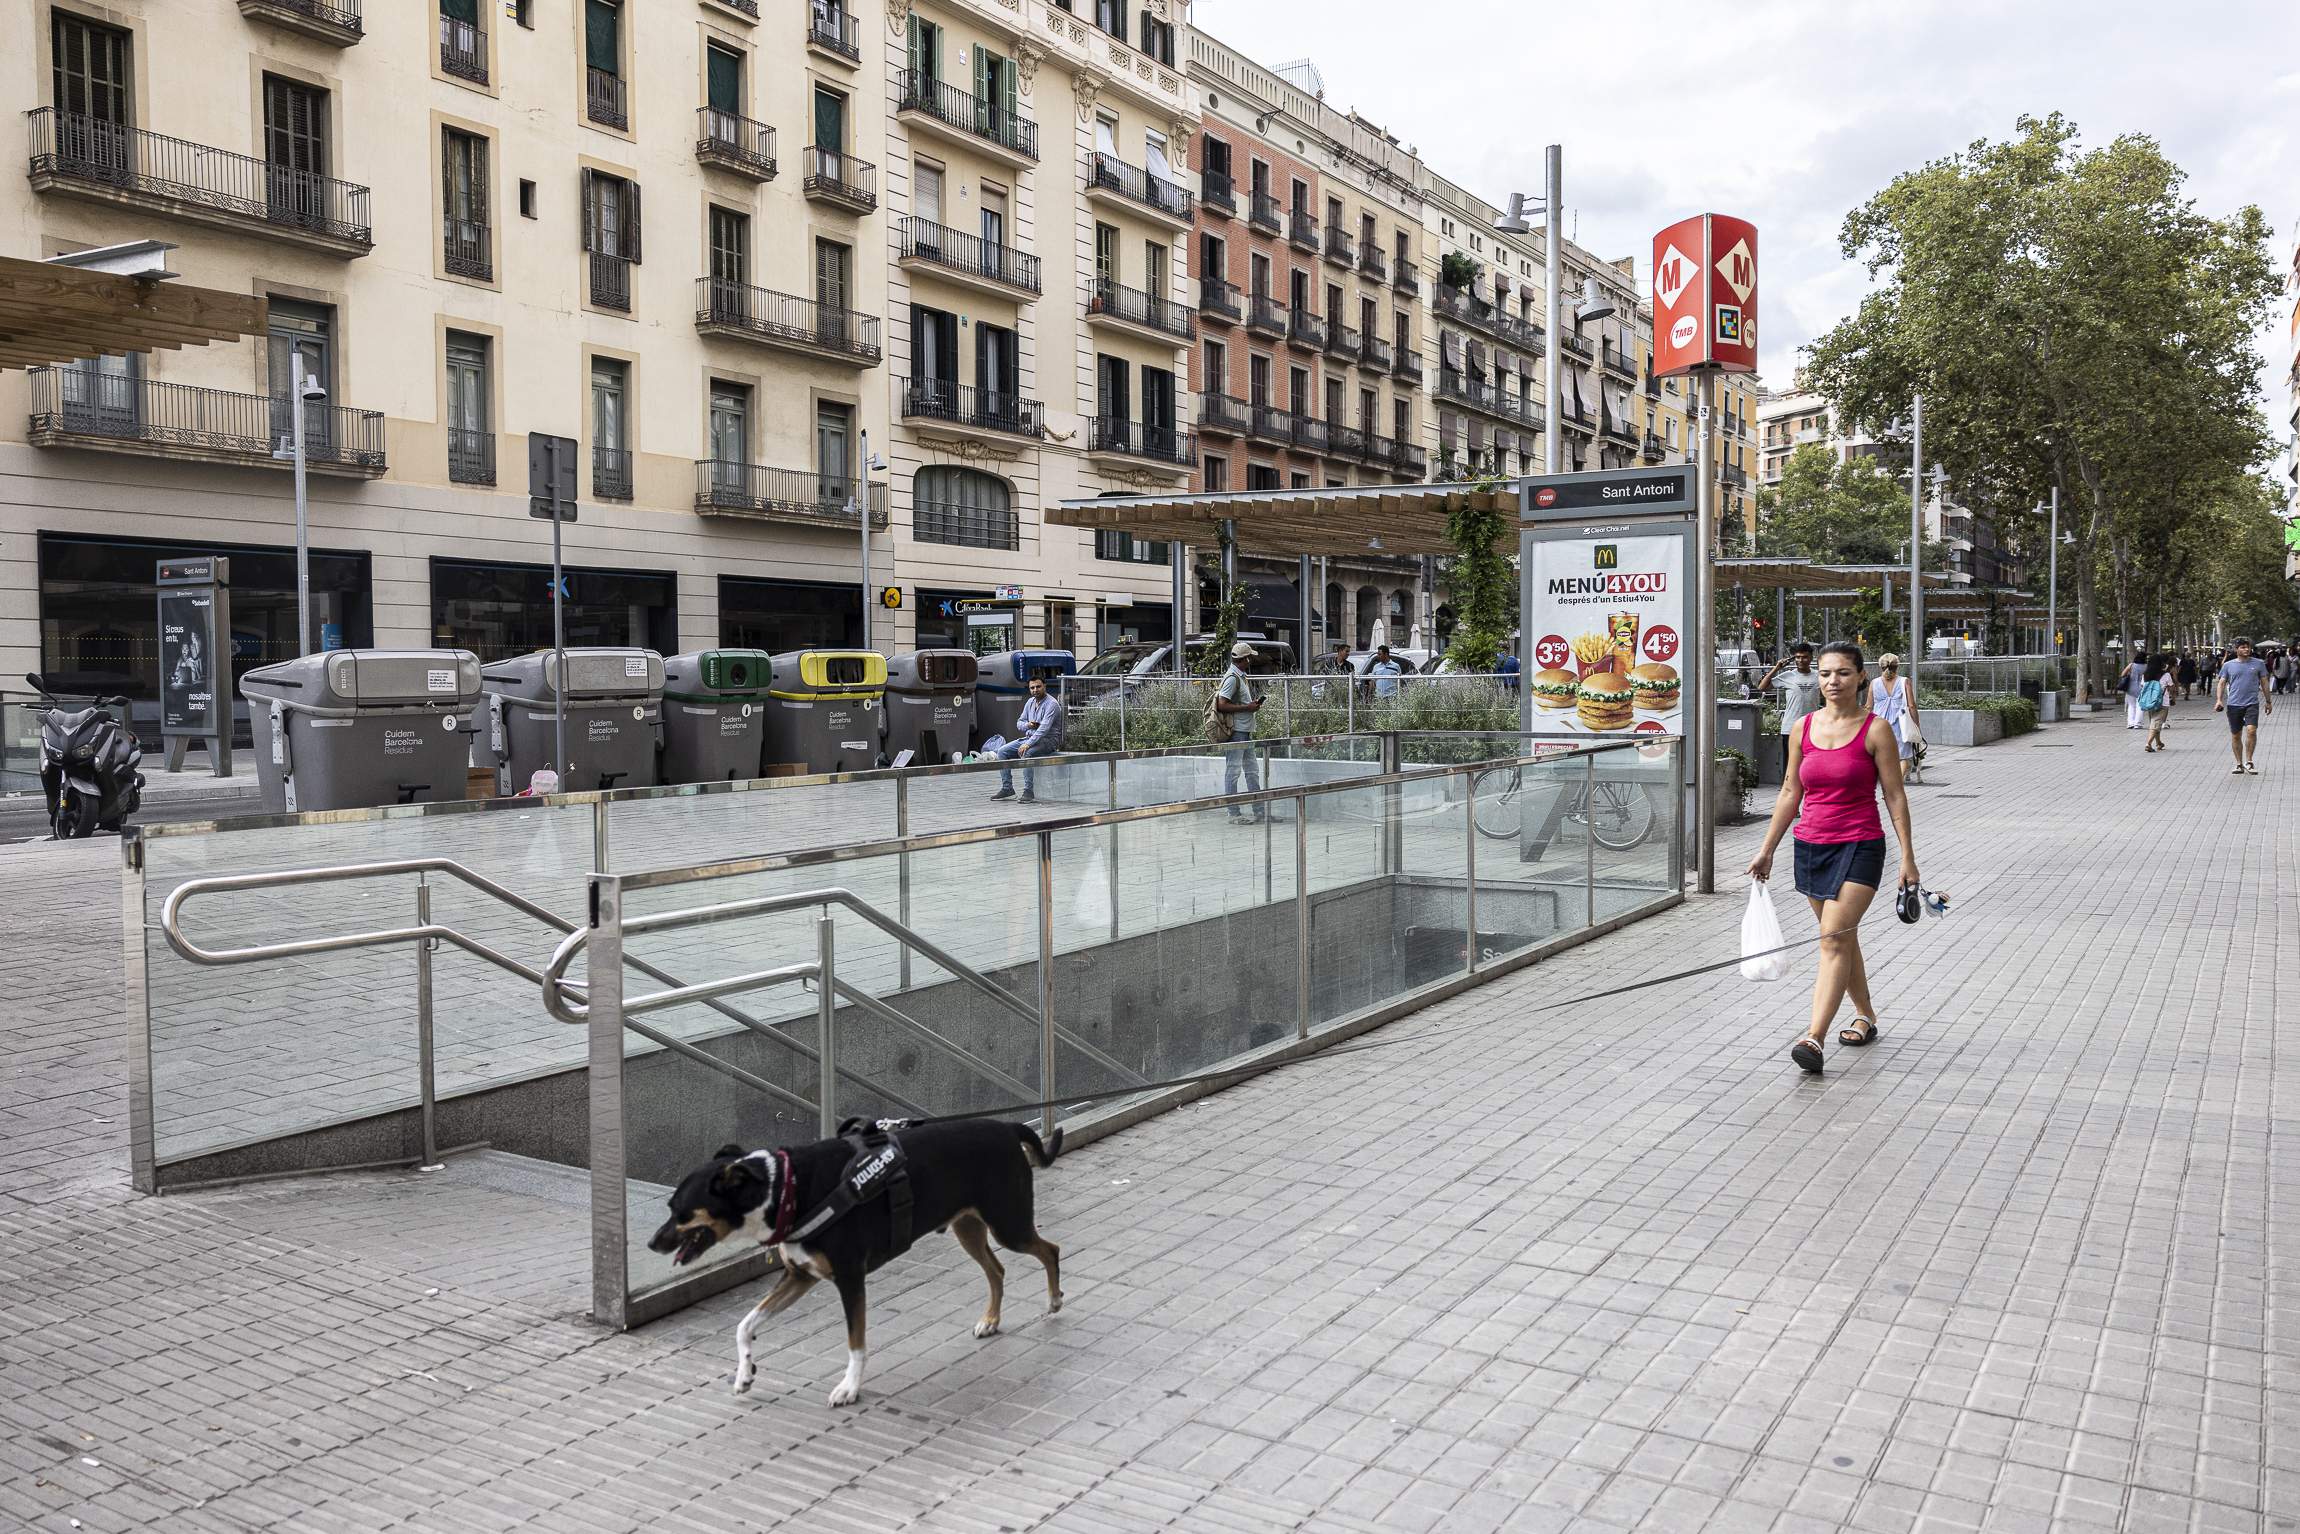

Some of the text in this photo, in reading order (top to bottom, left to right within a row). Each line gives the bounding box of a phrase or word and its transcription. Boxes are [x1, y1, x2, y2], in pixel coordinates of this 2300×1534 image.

[1733, 253, 1750, 288] M
[1663, 258, 1681, 295] M
[1675, 326, 1694, 340] TMB
[1602, 482, 1674, 499] Sant Antoni
[1539, 494, 1554, 502] TMB
[184, 567, 194, 575] Sant
[1557, 594, 1655, 606] després d'un Estiu4You
[447, 719, 453, 727] R
[588, 719, 613, 728] Cuidem
[721, 716, 742, 724] Cuidem
[384, 729, 415, 738] Cuidem
[588, 727, 619, 735] Barcelona
[384, 738, 423, 747] Barcelona
